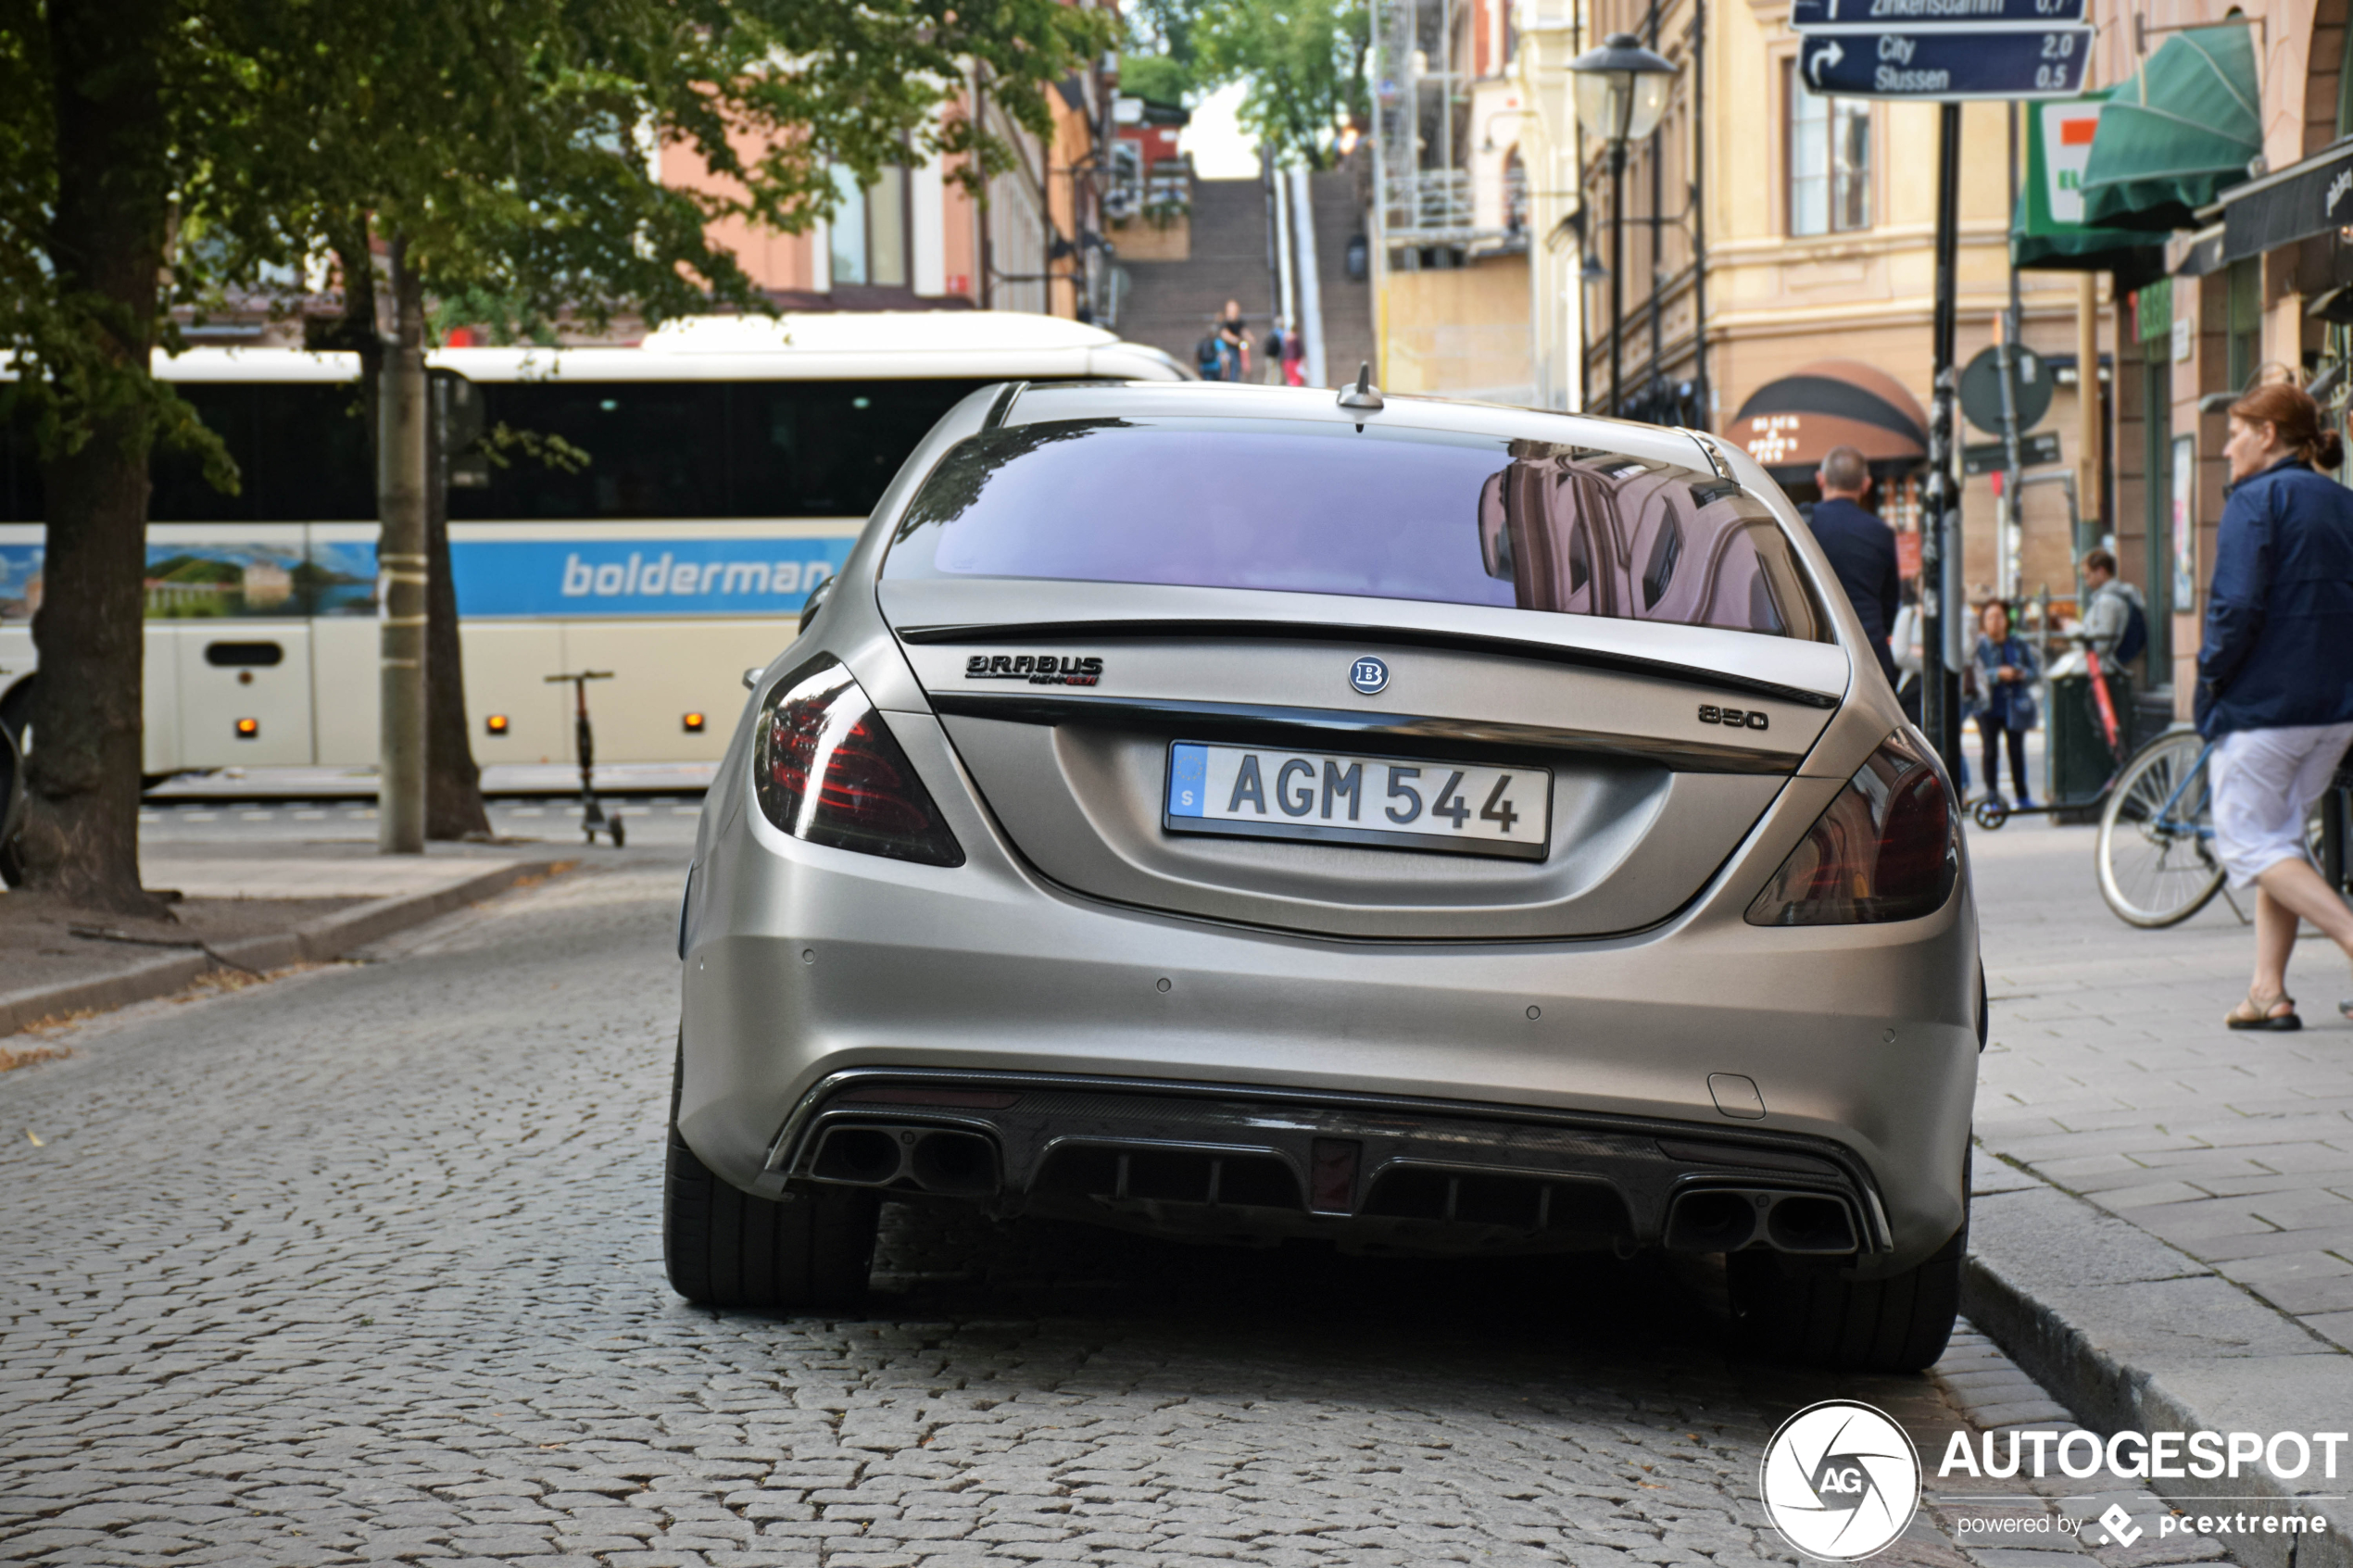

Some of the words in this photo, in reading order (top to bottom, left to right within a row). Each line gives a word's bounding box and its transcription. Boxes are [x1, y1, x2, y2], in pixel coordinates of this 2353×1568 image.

[1877, 34, 1916, 65] City
[2041, 34, 2074, 60] 2,0
[1874, 66, 1949, 91] Slussen
[561, 552, 834, 596] bolderman
[966, 655, 1103, 674] BRABUS
[1356, 662, 1383, 685] B
[1698, 704, 1768, 731] 850
[1181, 790, 1193, 806] S
[1227, 754, 1363, 822] AGM
[1384, 766, 1518, 833] 544
